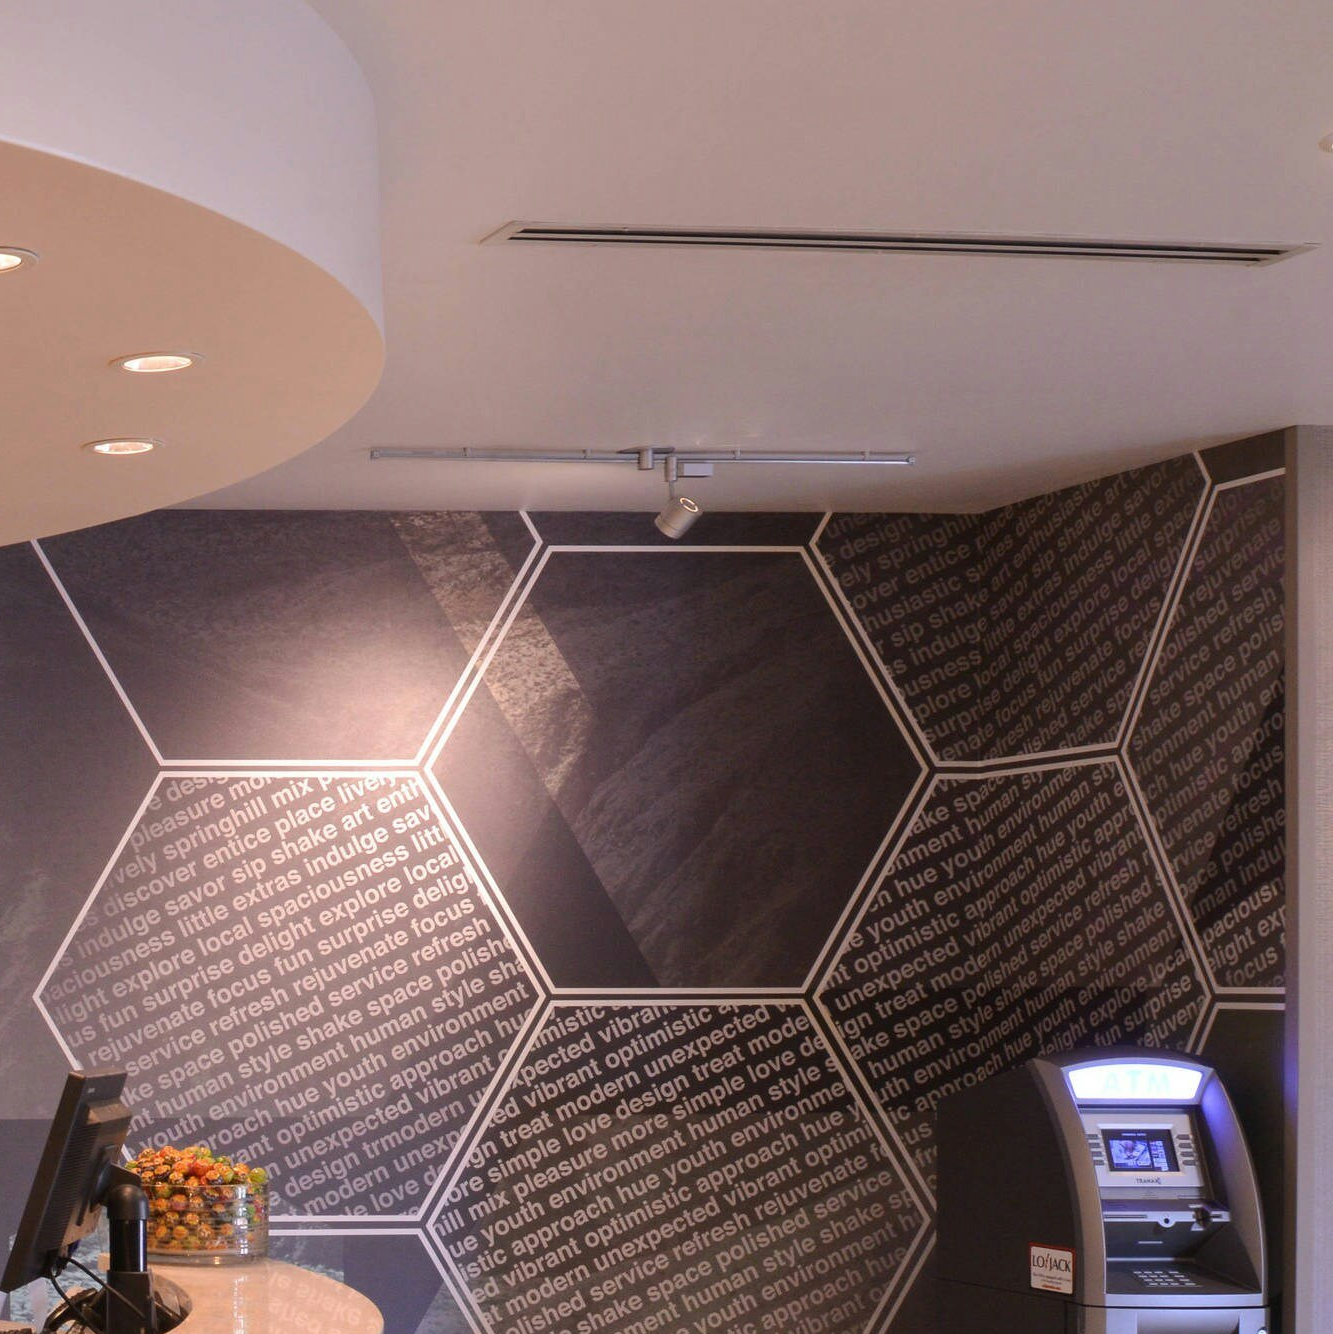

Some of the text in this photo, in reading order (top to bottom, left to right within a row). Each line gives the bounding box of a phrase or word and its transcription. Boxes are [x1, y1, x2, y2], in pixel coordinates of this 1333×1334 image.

[890, 562, 1011, 648] sip shake art
[905, 543, 971, 584] entice
[974, 549, 1114, 688] local spaciousness
[983, 512, 1121, 654] little extras indulge
[1003, 583, 1110, 692] delight explore
[1036, 596, 1161, 720] rejuvenate focus
[1150, 588, 1277, 706] service refresh
[1218, 650, 1279, 710] human
[1169, 701, 1257, 781] hue youth
[1231, 745, 1284, 794] focus
[101, 795, 334, 916] discover entice place
[129, 792, 224, 851] pleasure
[163, 777, 311, 858] springhill mix
[868, 780, 1090, 942] youth environment human
[894, 834, 996, 898] hue youth
[965, 790, 1111, 921] approach hue youth
[966, 785, 1020, 835] human
[1218, 778, 1282, 837] refresh
[76, 800, 371, 956] indulge savor sip shake art
[97, 843, 458, 1031] fun surprise delight explore local
[111, 843, 409, 997] explore local spaciousness
[178, 825, 387, 935] little extras indulge
[963, 838, 1092, 946] vibrant optimistic
[1004, 822, 1143, 946] unexpected vibrant
[1031, 859, 1140, 955] service refresh
[1086, 876, 1152, 945] polished
[1117, 901, 1165, 945] shake
[125, 897, 473, 1075] service refresh rejuvenate focus
[155, 974, 432, 1116] human style shake space
[207, 976, 485, 1120] environment human style
[274, 979, 527, 1115] hue youth environment
[276, 1025, 491, 1143] optimistic approach
[499, 1002, 768, 1146] treat modern unexpected
[524, 1006, 711, 1107] vibrant optimistic
[282, 1100, 463, 1196] design trmodern
[285, 1053, 493, 1167] unexpected vibrant
[469, 1050, 795, 1219] mix pleasure more simple love
[481, 1065, 820, 1246] youth environment human style
[487, 1042, 743, 1182] simple love design treat
[503, 1110, 843, 1287] vibrant optimistic approach hue
[511, 1136, 725, 1254] approach hue youth
[577, 1294, 642, 1334] shake
[646, 1260, 711, 1301] space
[715, 1207, 809, 1272] polished
[813, 1171, 892, 1218] service
[589, 1155, 868, 1301] service refresh rejuvenate
[680, 1265, 758, 1311] human
[762, 1237, 815, 1272] style
[819, 1203, 884, 1244] shake
[760, 1266, 862, 1329] approach
